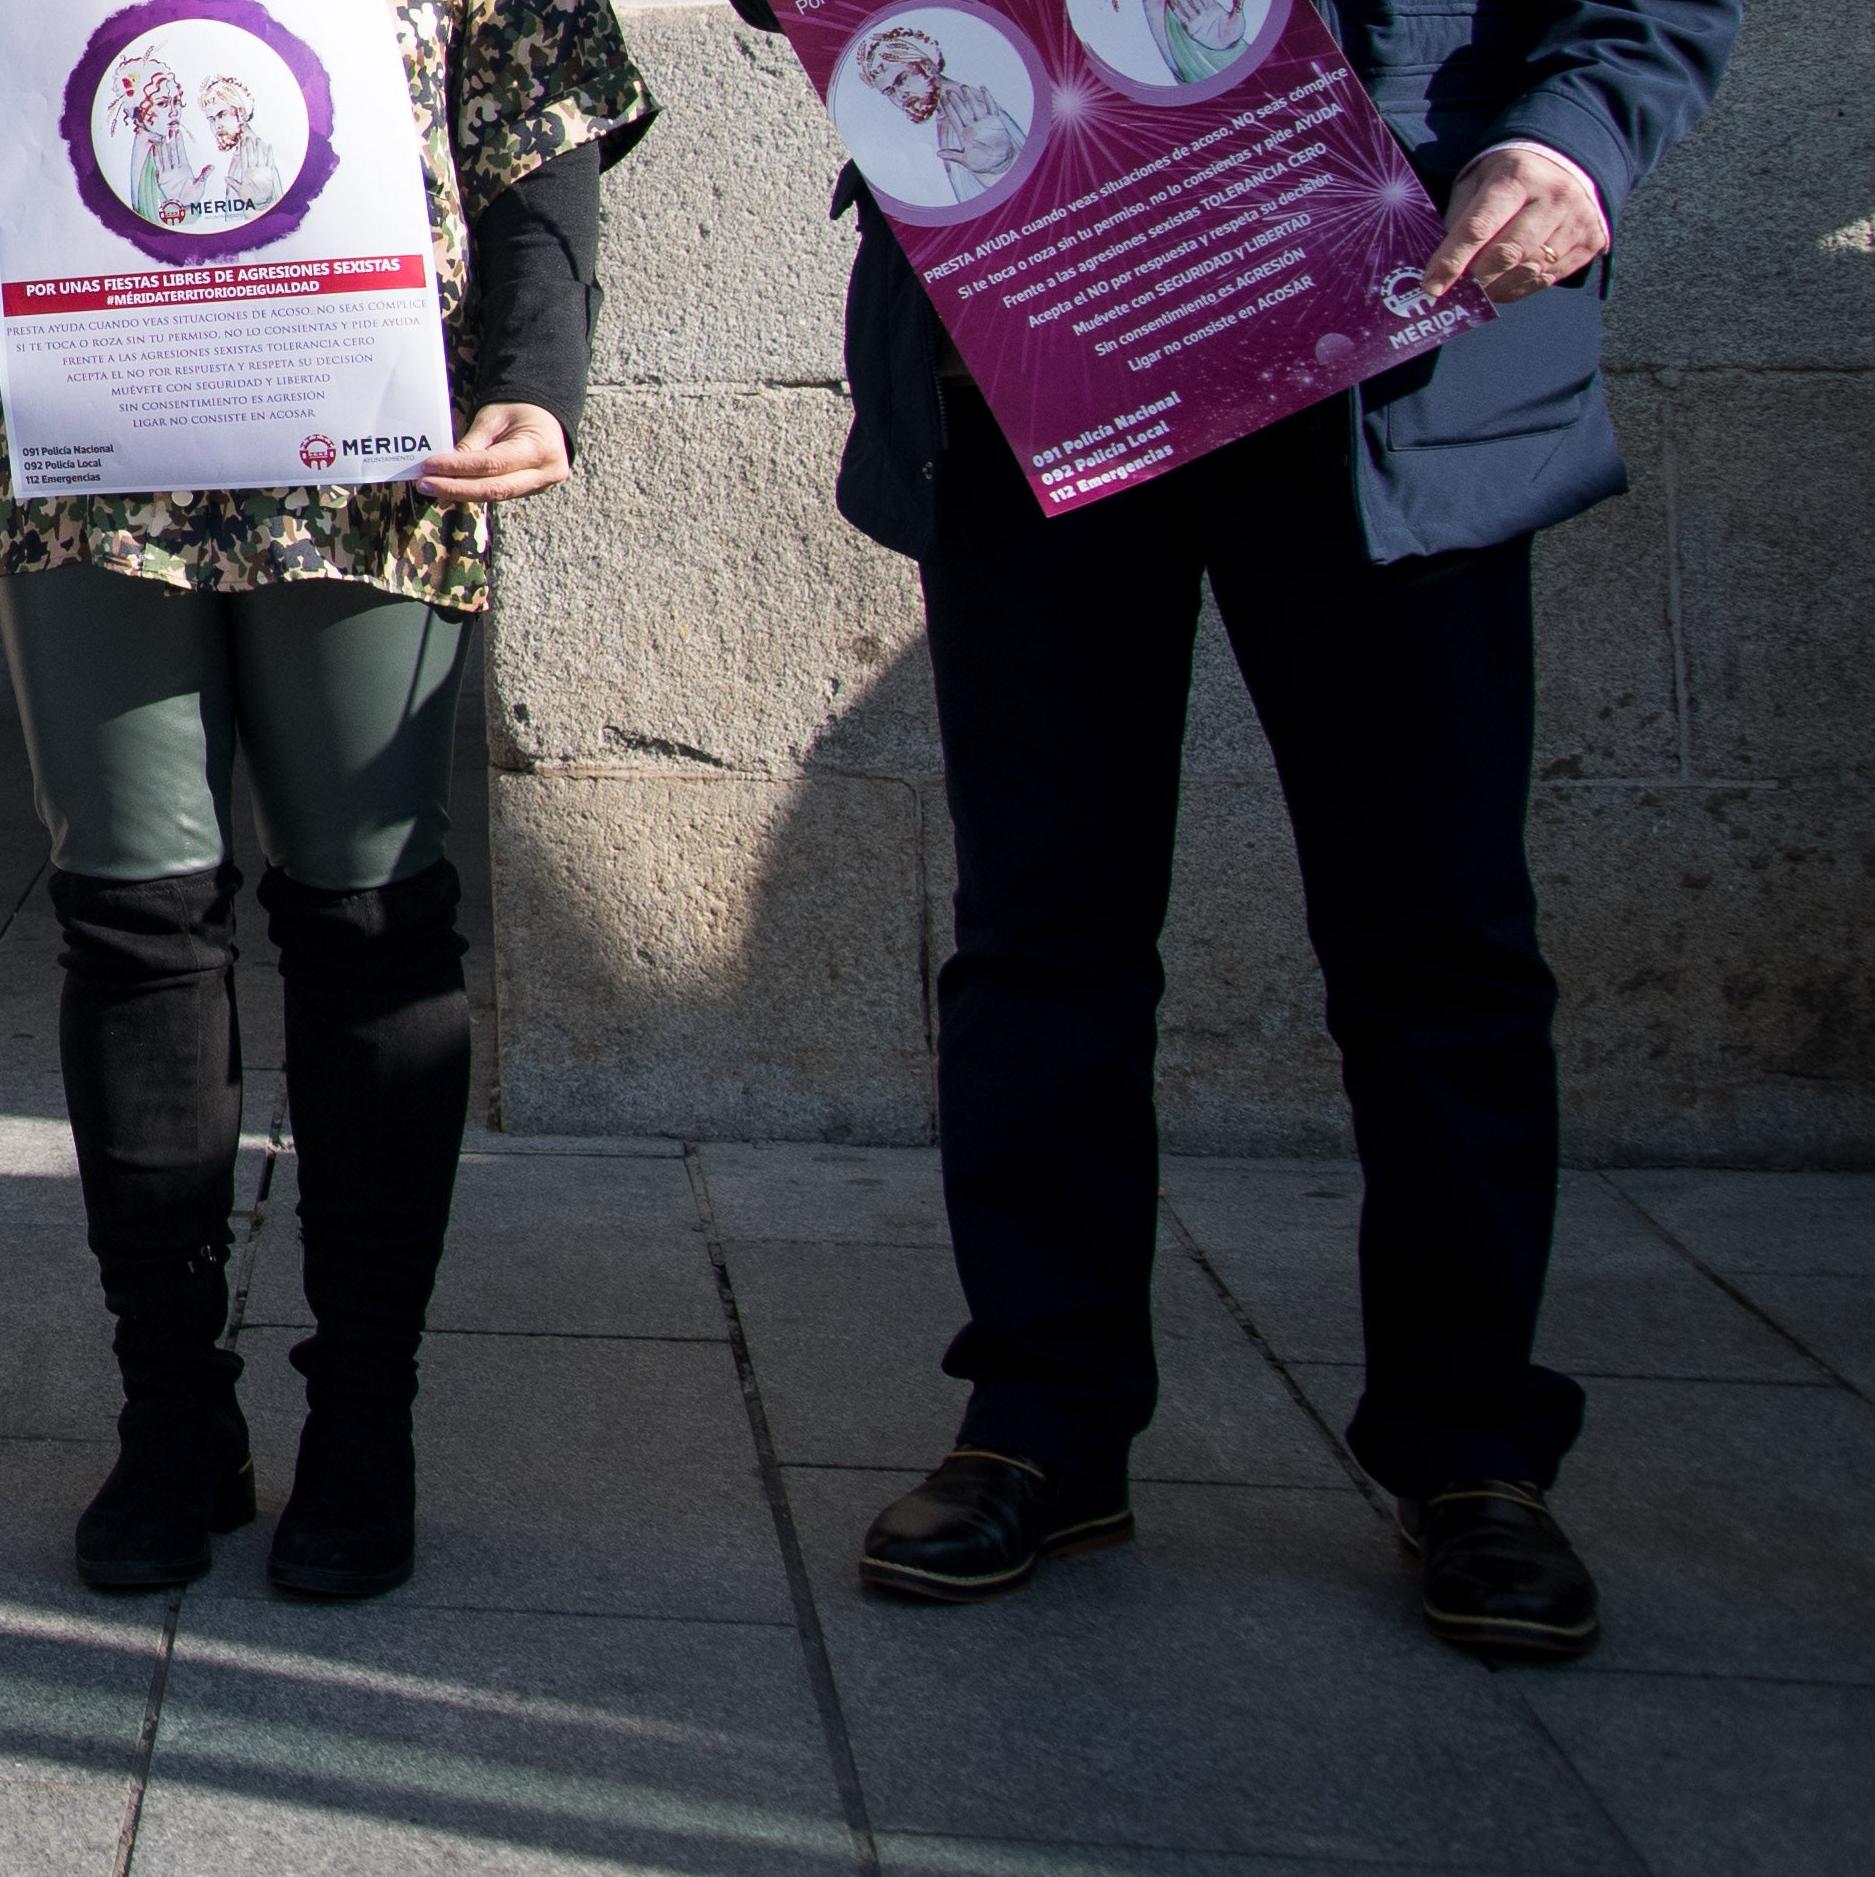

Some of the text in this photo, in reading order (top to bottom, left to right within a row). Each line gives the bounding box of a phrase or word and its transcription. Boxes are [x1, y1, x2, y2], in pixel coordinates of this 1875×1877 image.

[27, 258, 400, 296] POR UNAS FIESTAS LIBRES DE AGRESIONES SEXISTAS
